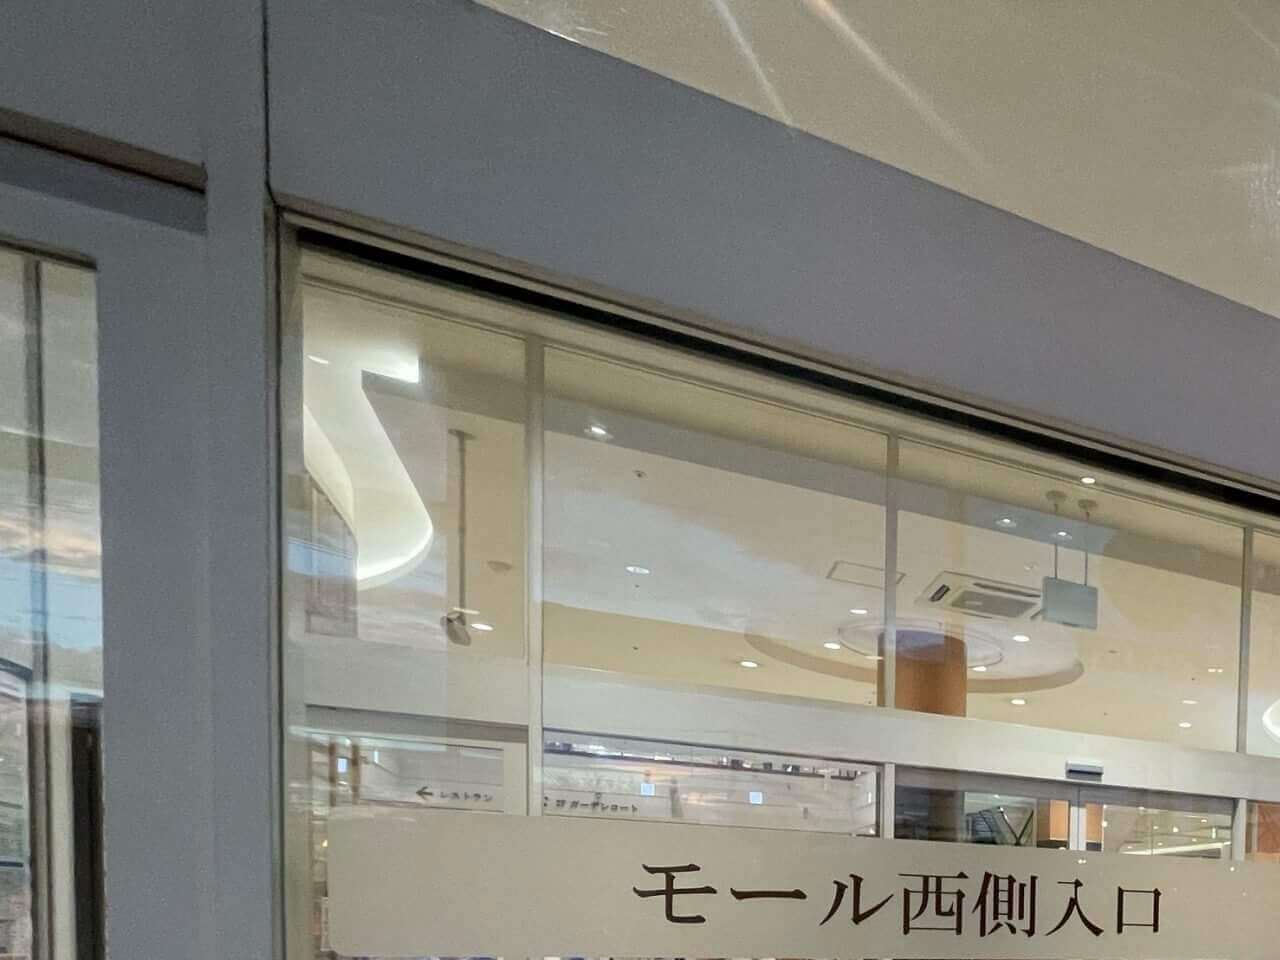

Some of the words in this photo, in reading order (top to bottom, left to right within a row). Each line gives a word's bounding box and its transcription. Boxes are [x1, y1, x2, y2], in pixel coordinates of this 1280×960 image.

[632, 862, 1162, 938] モール西側入口
